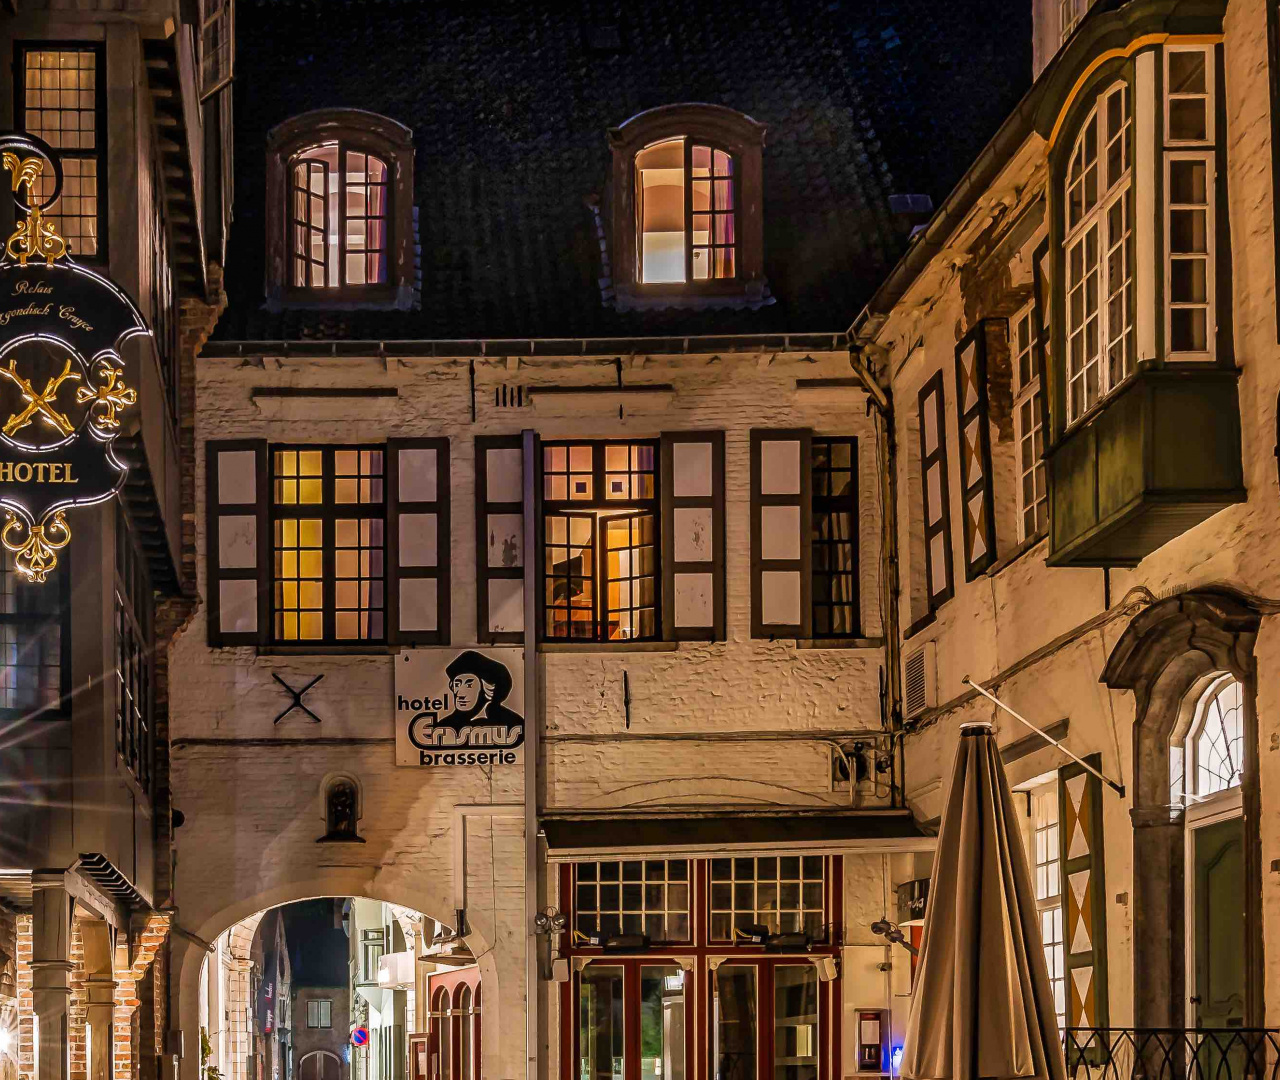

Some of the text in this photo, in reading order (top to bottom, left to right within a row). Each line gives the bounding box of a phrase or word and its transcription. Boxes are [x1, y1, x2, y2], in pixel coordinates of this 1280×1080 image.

[11, 280, 53, 296] Relais
[58, 303, 94, 332] Cruyce
[397, 693, 449, 711] hotel
[410, 715, 523, 747] Erasmus
[420, 750, 517, 766] brasserie
